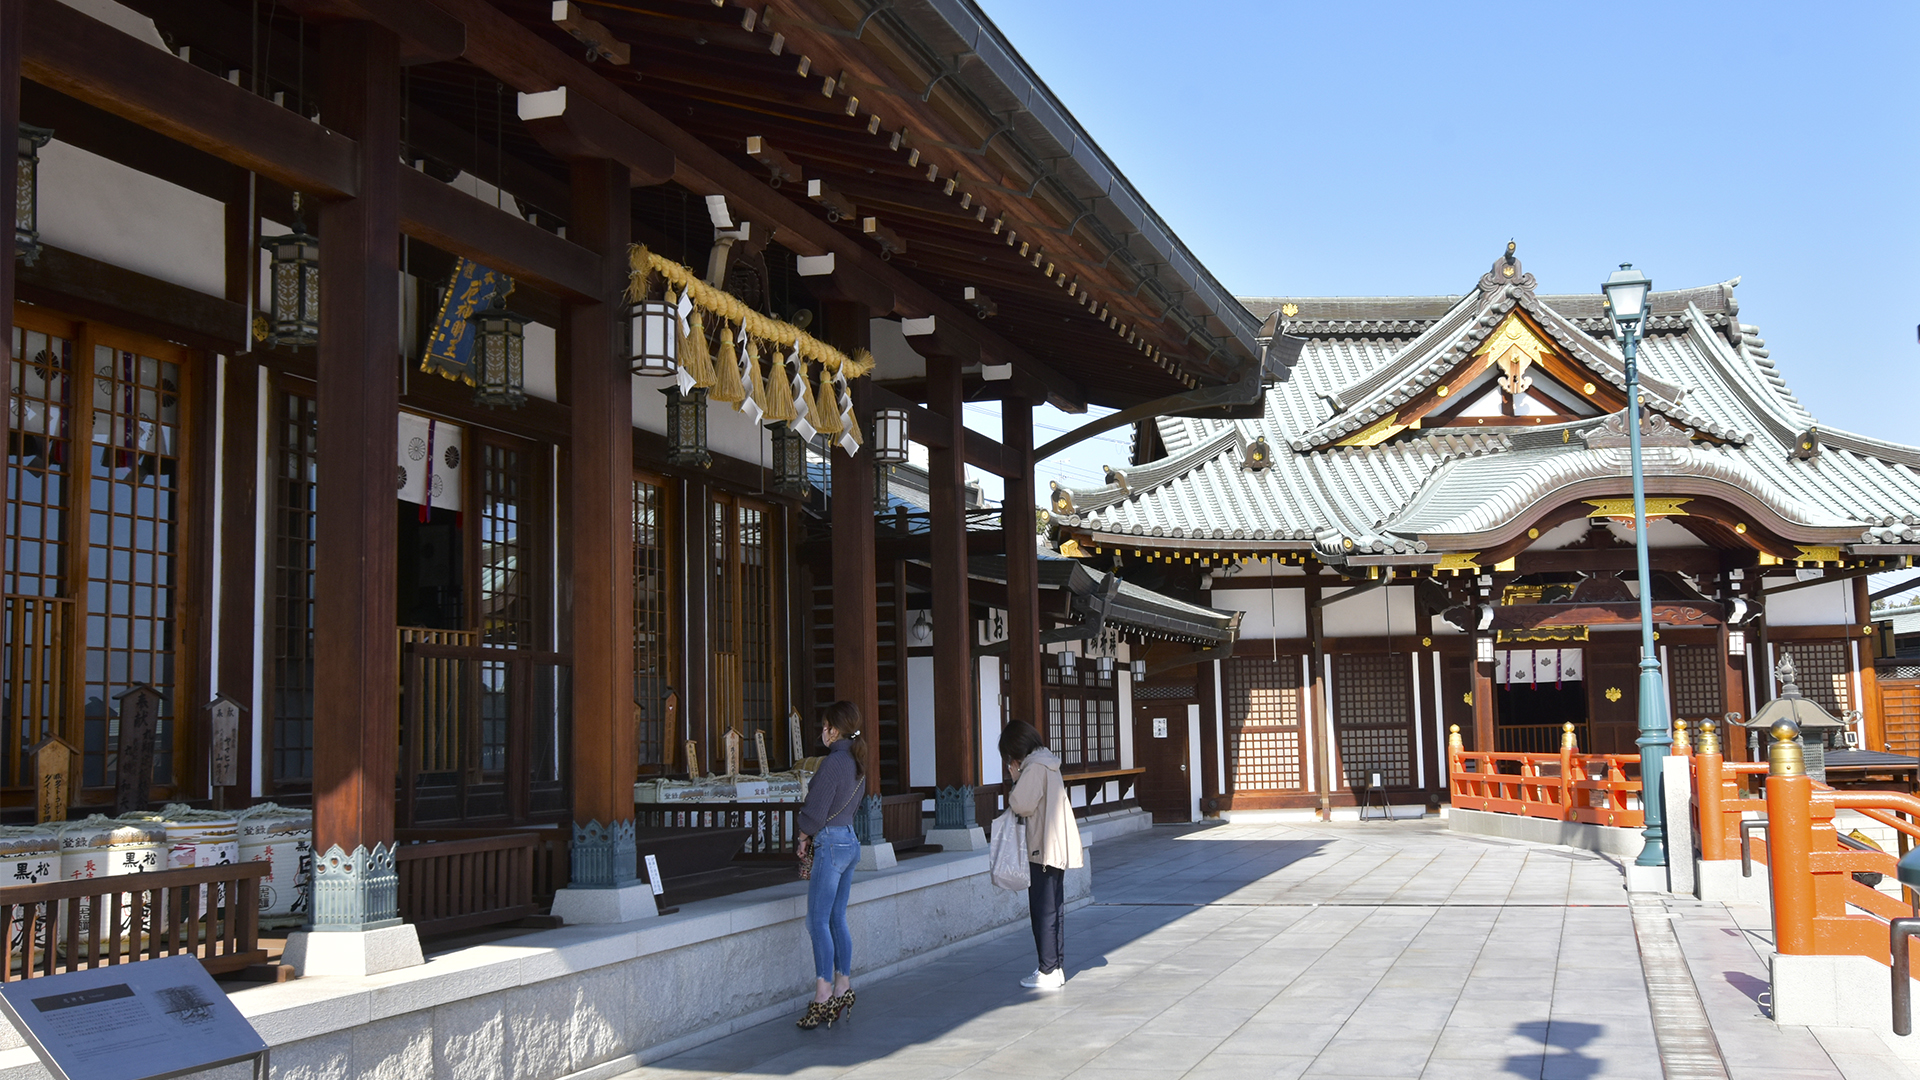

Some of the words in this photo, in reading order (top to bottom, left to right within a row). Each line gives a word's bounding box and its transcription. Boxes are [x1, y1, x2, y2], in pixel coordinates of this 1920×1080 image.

[63, 837, 88, 849] 登録
[122, 850, 158, 868] 黒松
[13, 861, 51, 880] 黒松
